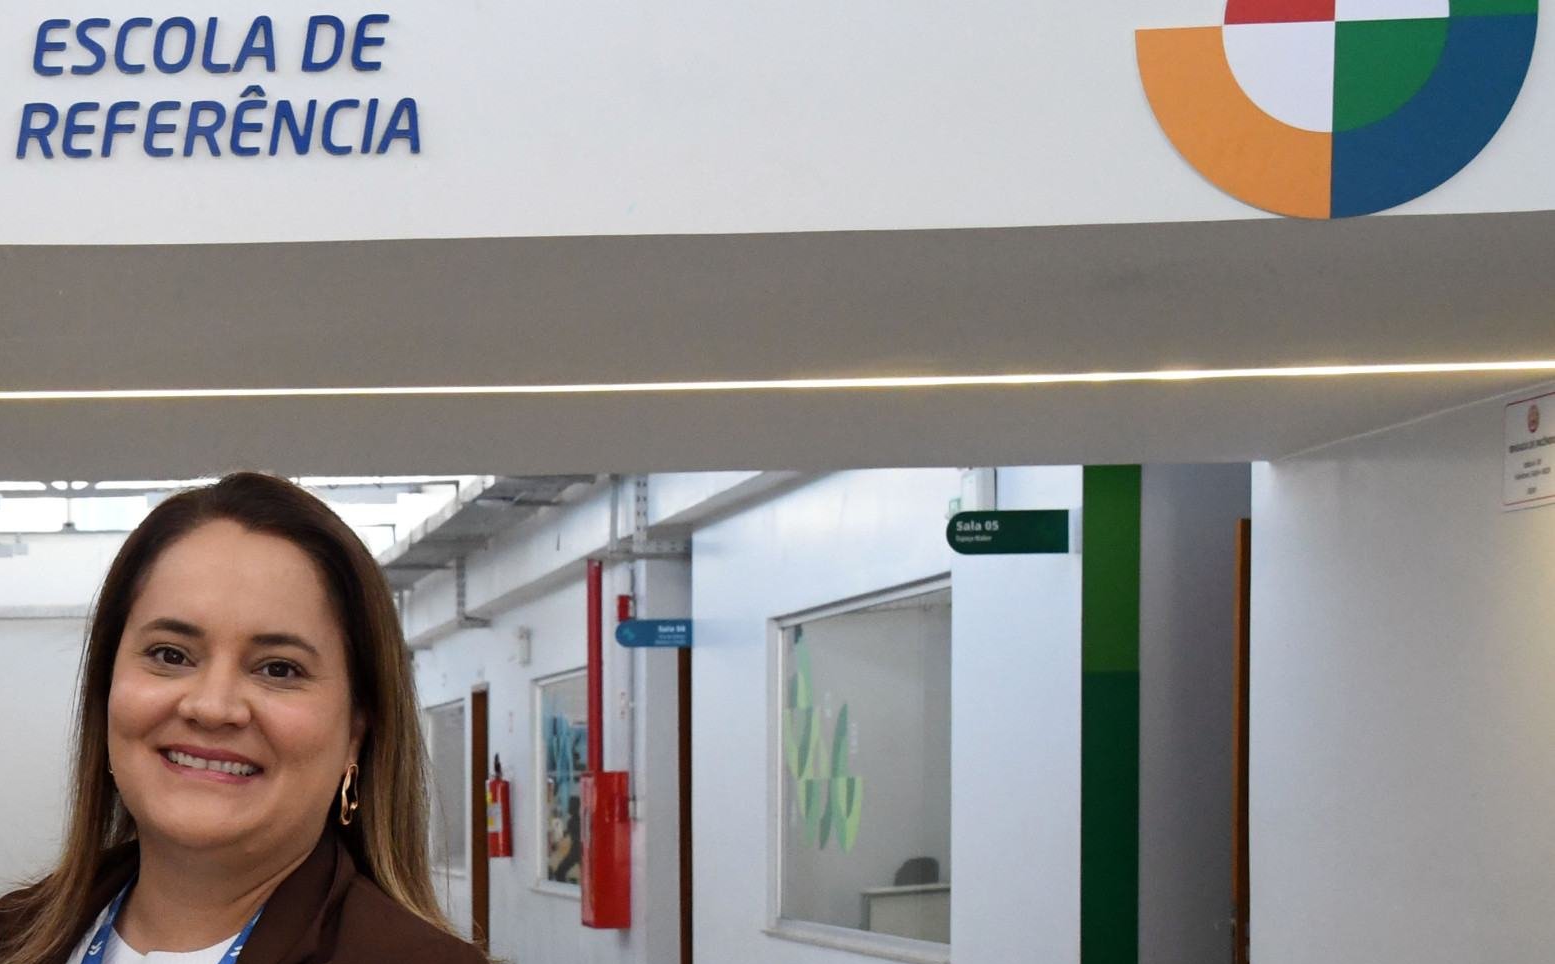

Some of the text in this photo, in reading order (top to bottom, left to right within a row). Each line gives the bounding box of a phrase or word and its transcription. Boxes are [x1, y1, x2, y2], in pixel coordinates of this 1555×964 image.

[32, 13, 390, 78] ESCOLA DE
[15, 84, 422, 160] REFERÊNCIA
[955, 520, 999, 531] Sala 05
